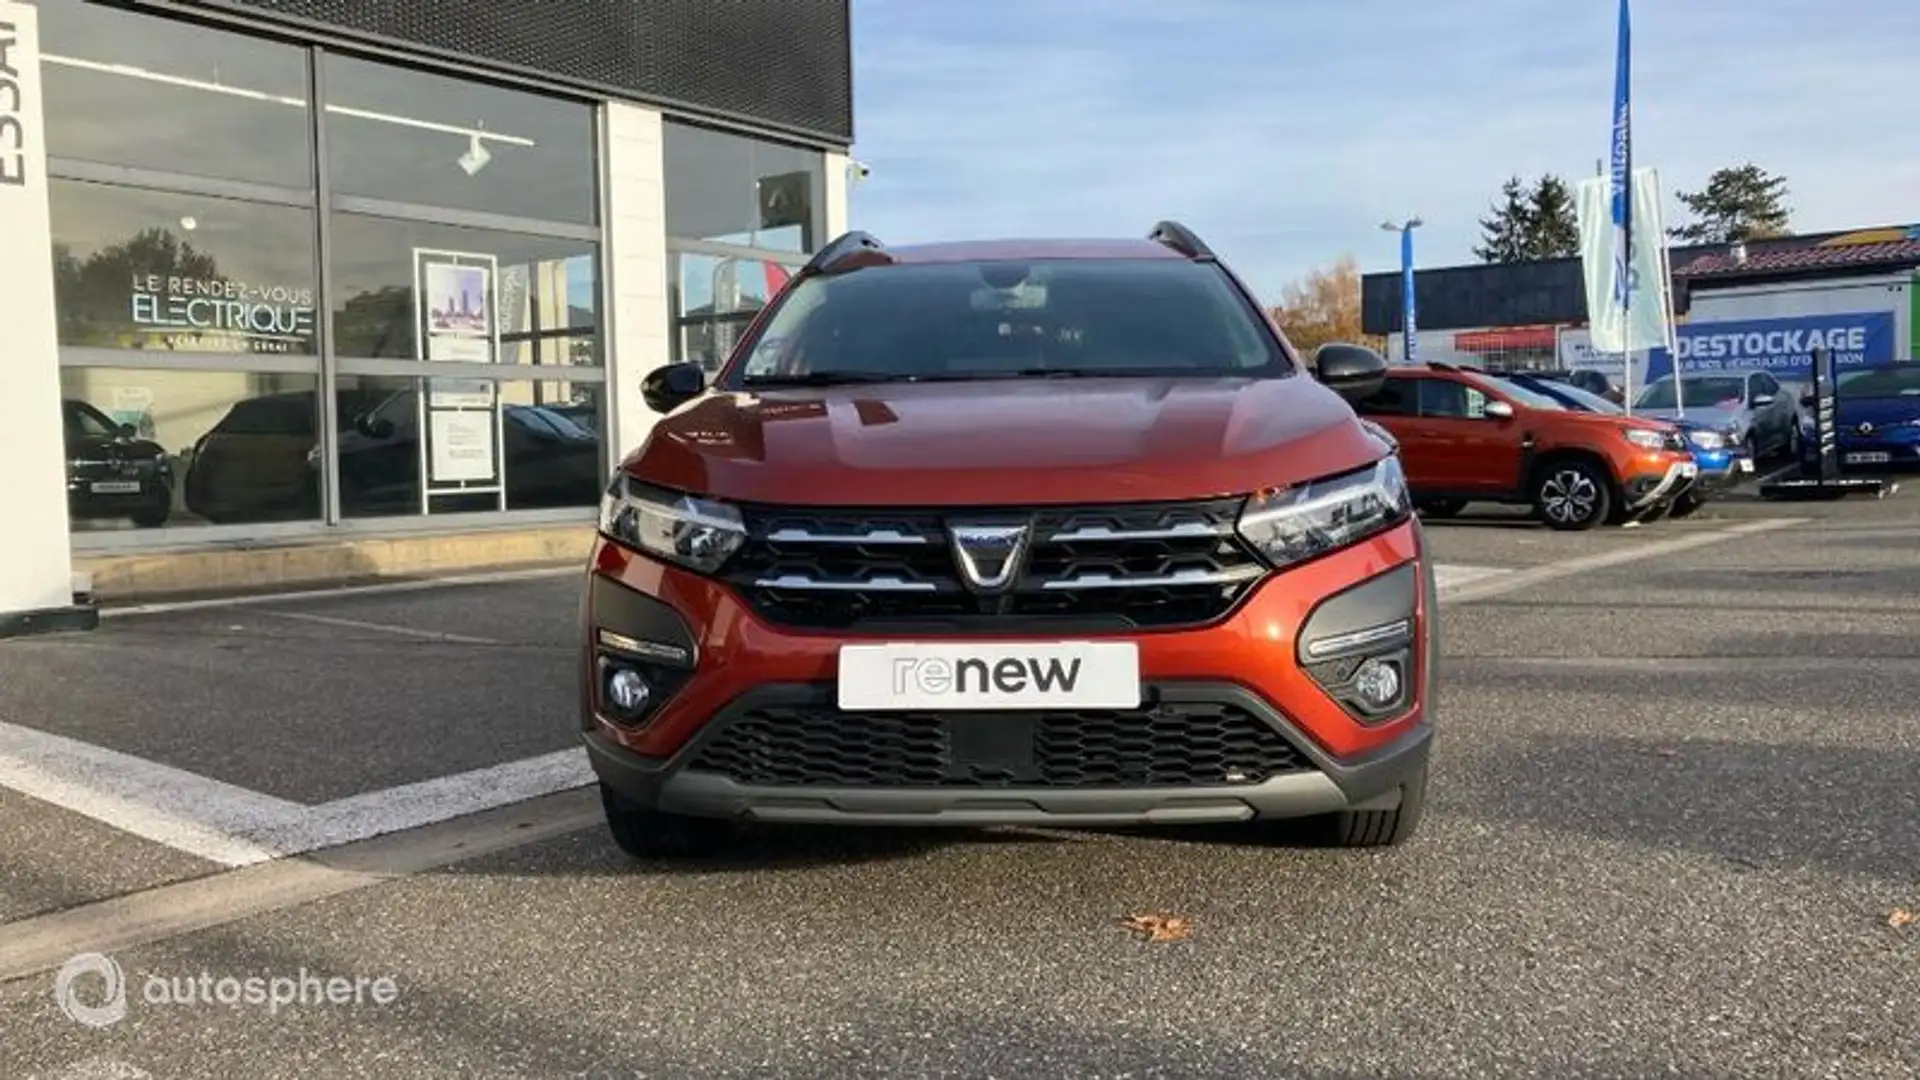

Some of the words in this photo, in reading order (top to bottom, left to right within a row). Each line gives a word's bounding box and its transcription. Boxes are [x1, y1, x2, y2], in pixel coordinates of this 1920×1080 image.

[132, 274, 160, 292] LE
[168, 275, 312, 305] RENDEZ-VOUS
[1677, 327, 1866, 358] DESTOCKAGE
[892, 657, 1082, 695] renew
